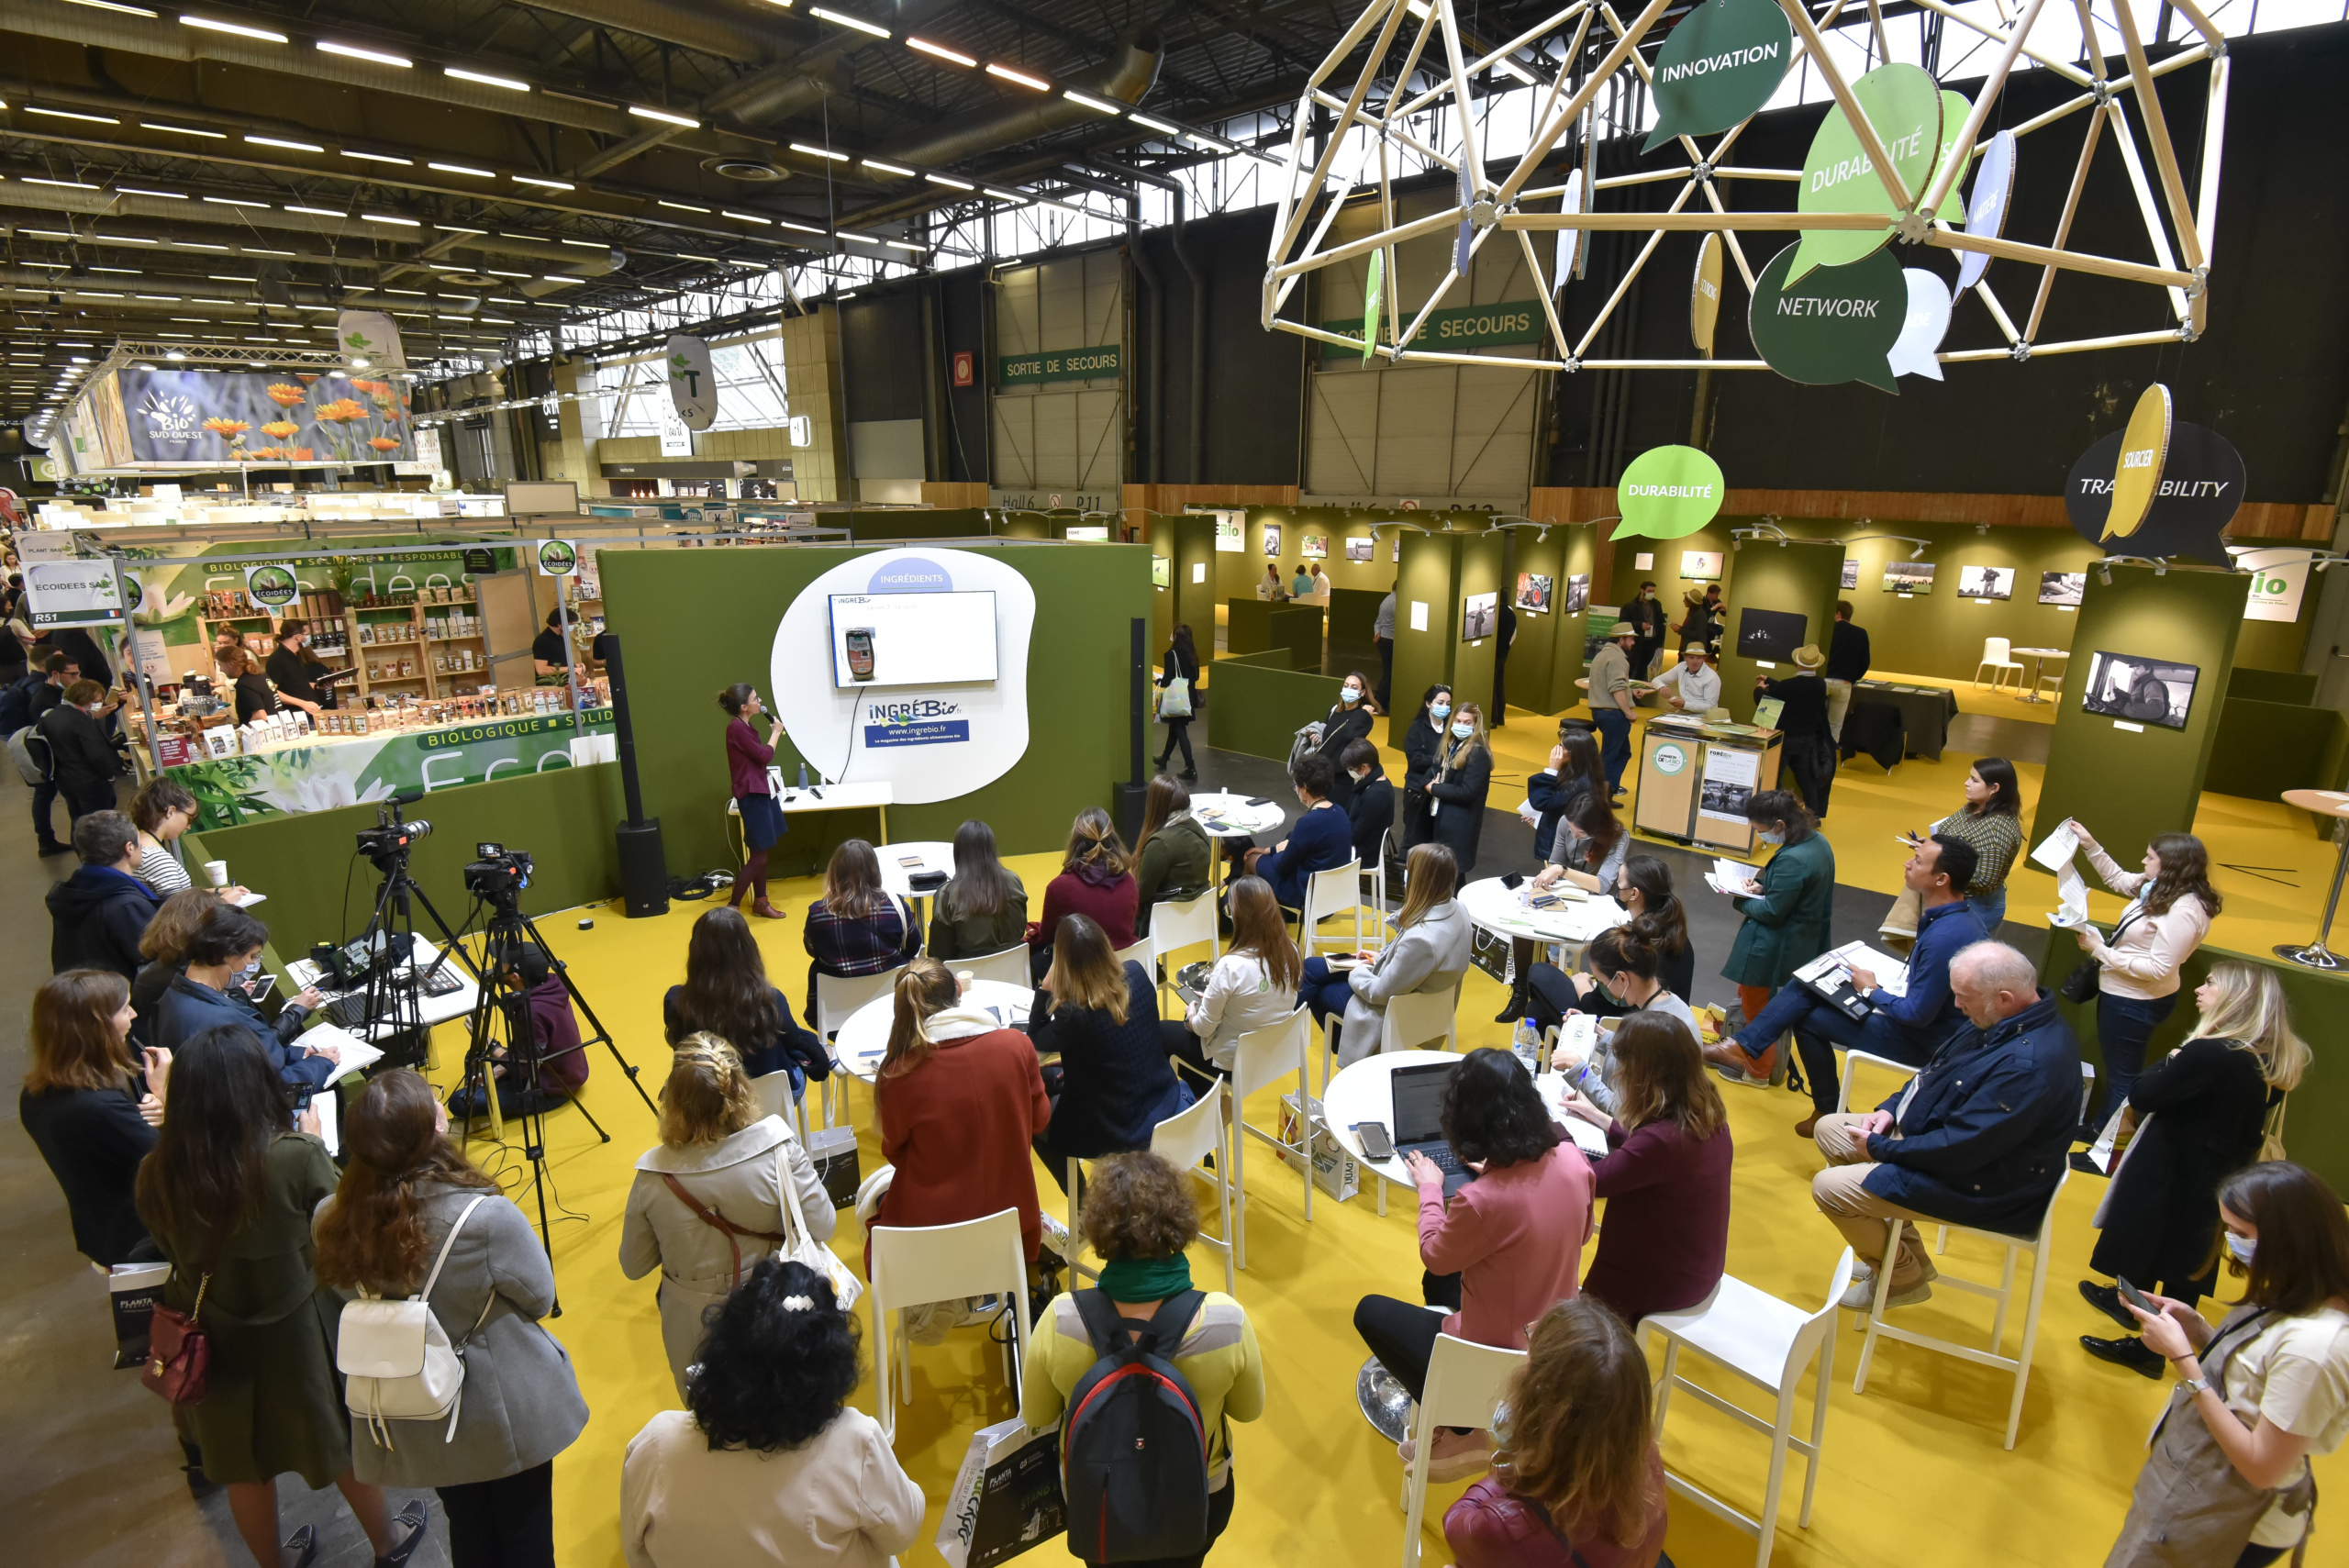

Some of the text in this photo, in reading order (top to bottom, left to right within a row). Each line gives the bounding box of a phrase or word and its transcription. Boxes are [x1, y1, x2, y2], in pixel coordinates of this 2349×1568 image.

[1662, 41, 1778, 83] INNOVATION
[1776, 297, 1880, 317] NETWORK
[1440, 313, 1530, 339] SECOURS
[1007, 354, 1117, 376] SORTIE DE SECOURS
[684, 370, 700, 397] T
[150, 431, 169, 439] SUD
[1628, 484, 1713, 498] DURABILITÉ
[1003, 495, 1025, 507] Hall
[1028, 495, 1034, 508] 6
[881, 573, 943, 584] INGRÉDIENTS
[36, 581, 109, 592] ECOIDEES SAS
[256, 589, 294, 597] ÉCOIDÉES
[35, 614, 57, 622] R51
[429, 720, 540, 747] BIOLOGIQUE
[888, 725, 946, 736] www.ingrebio.fr
[1020, 1485, 1050, 1510] STAND
